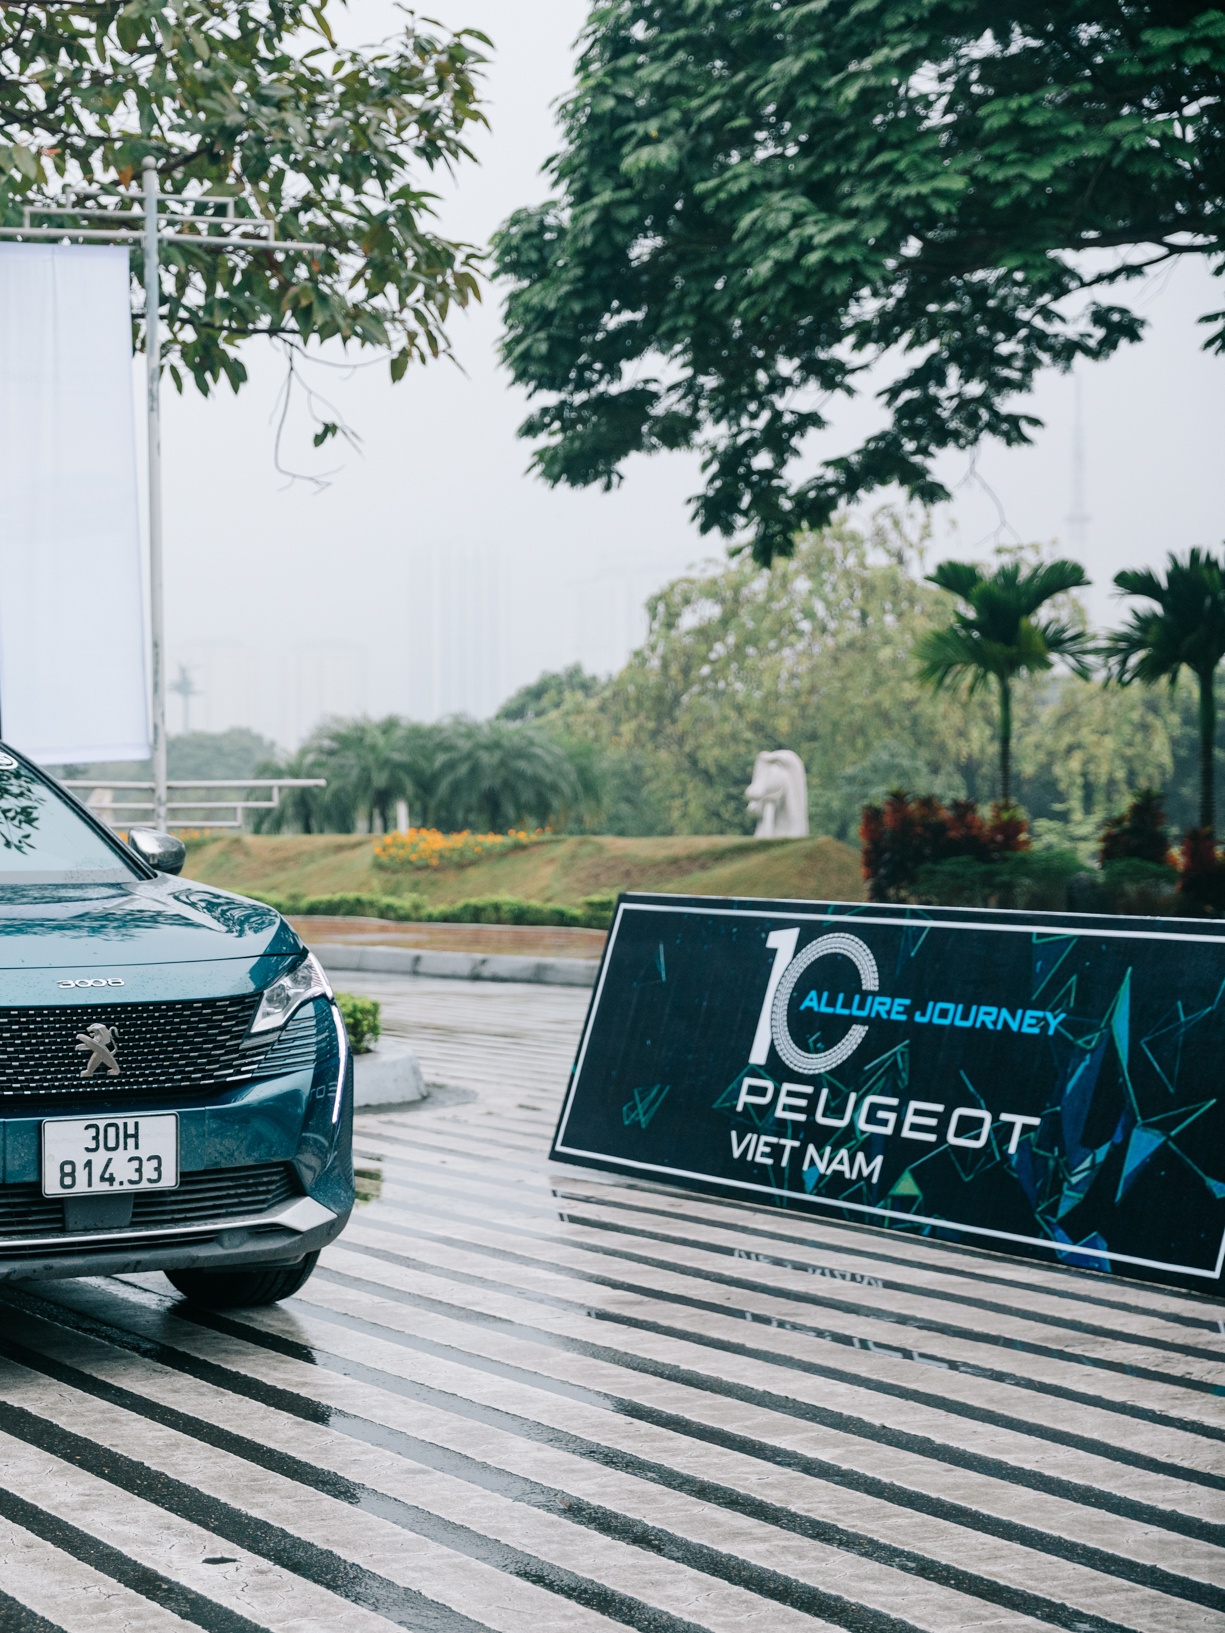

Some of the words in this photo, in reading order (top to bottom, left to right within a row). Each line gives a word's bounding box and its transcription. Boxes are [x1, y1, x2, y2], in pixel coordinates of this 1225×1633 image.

[57, 978, 125, 988] 3008
[749, 927, 879, 1074] 10
[800, 990, 910, 1021] ALLURE
[915, 1002, 1067, 1035] JOURNEY
[84, 1122, 139, 1152] 30H
[736, 1077, 1041, 1154] PEUGEOT
[59, 1155, 162, 1189] 814.33
[730, 1130, 800, 1166] VIET
[802, 1144, 884, 1184] NAM
